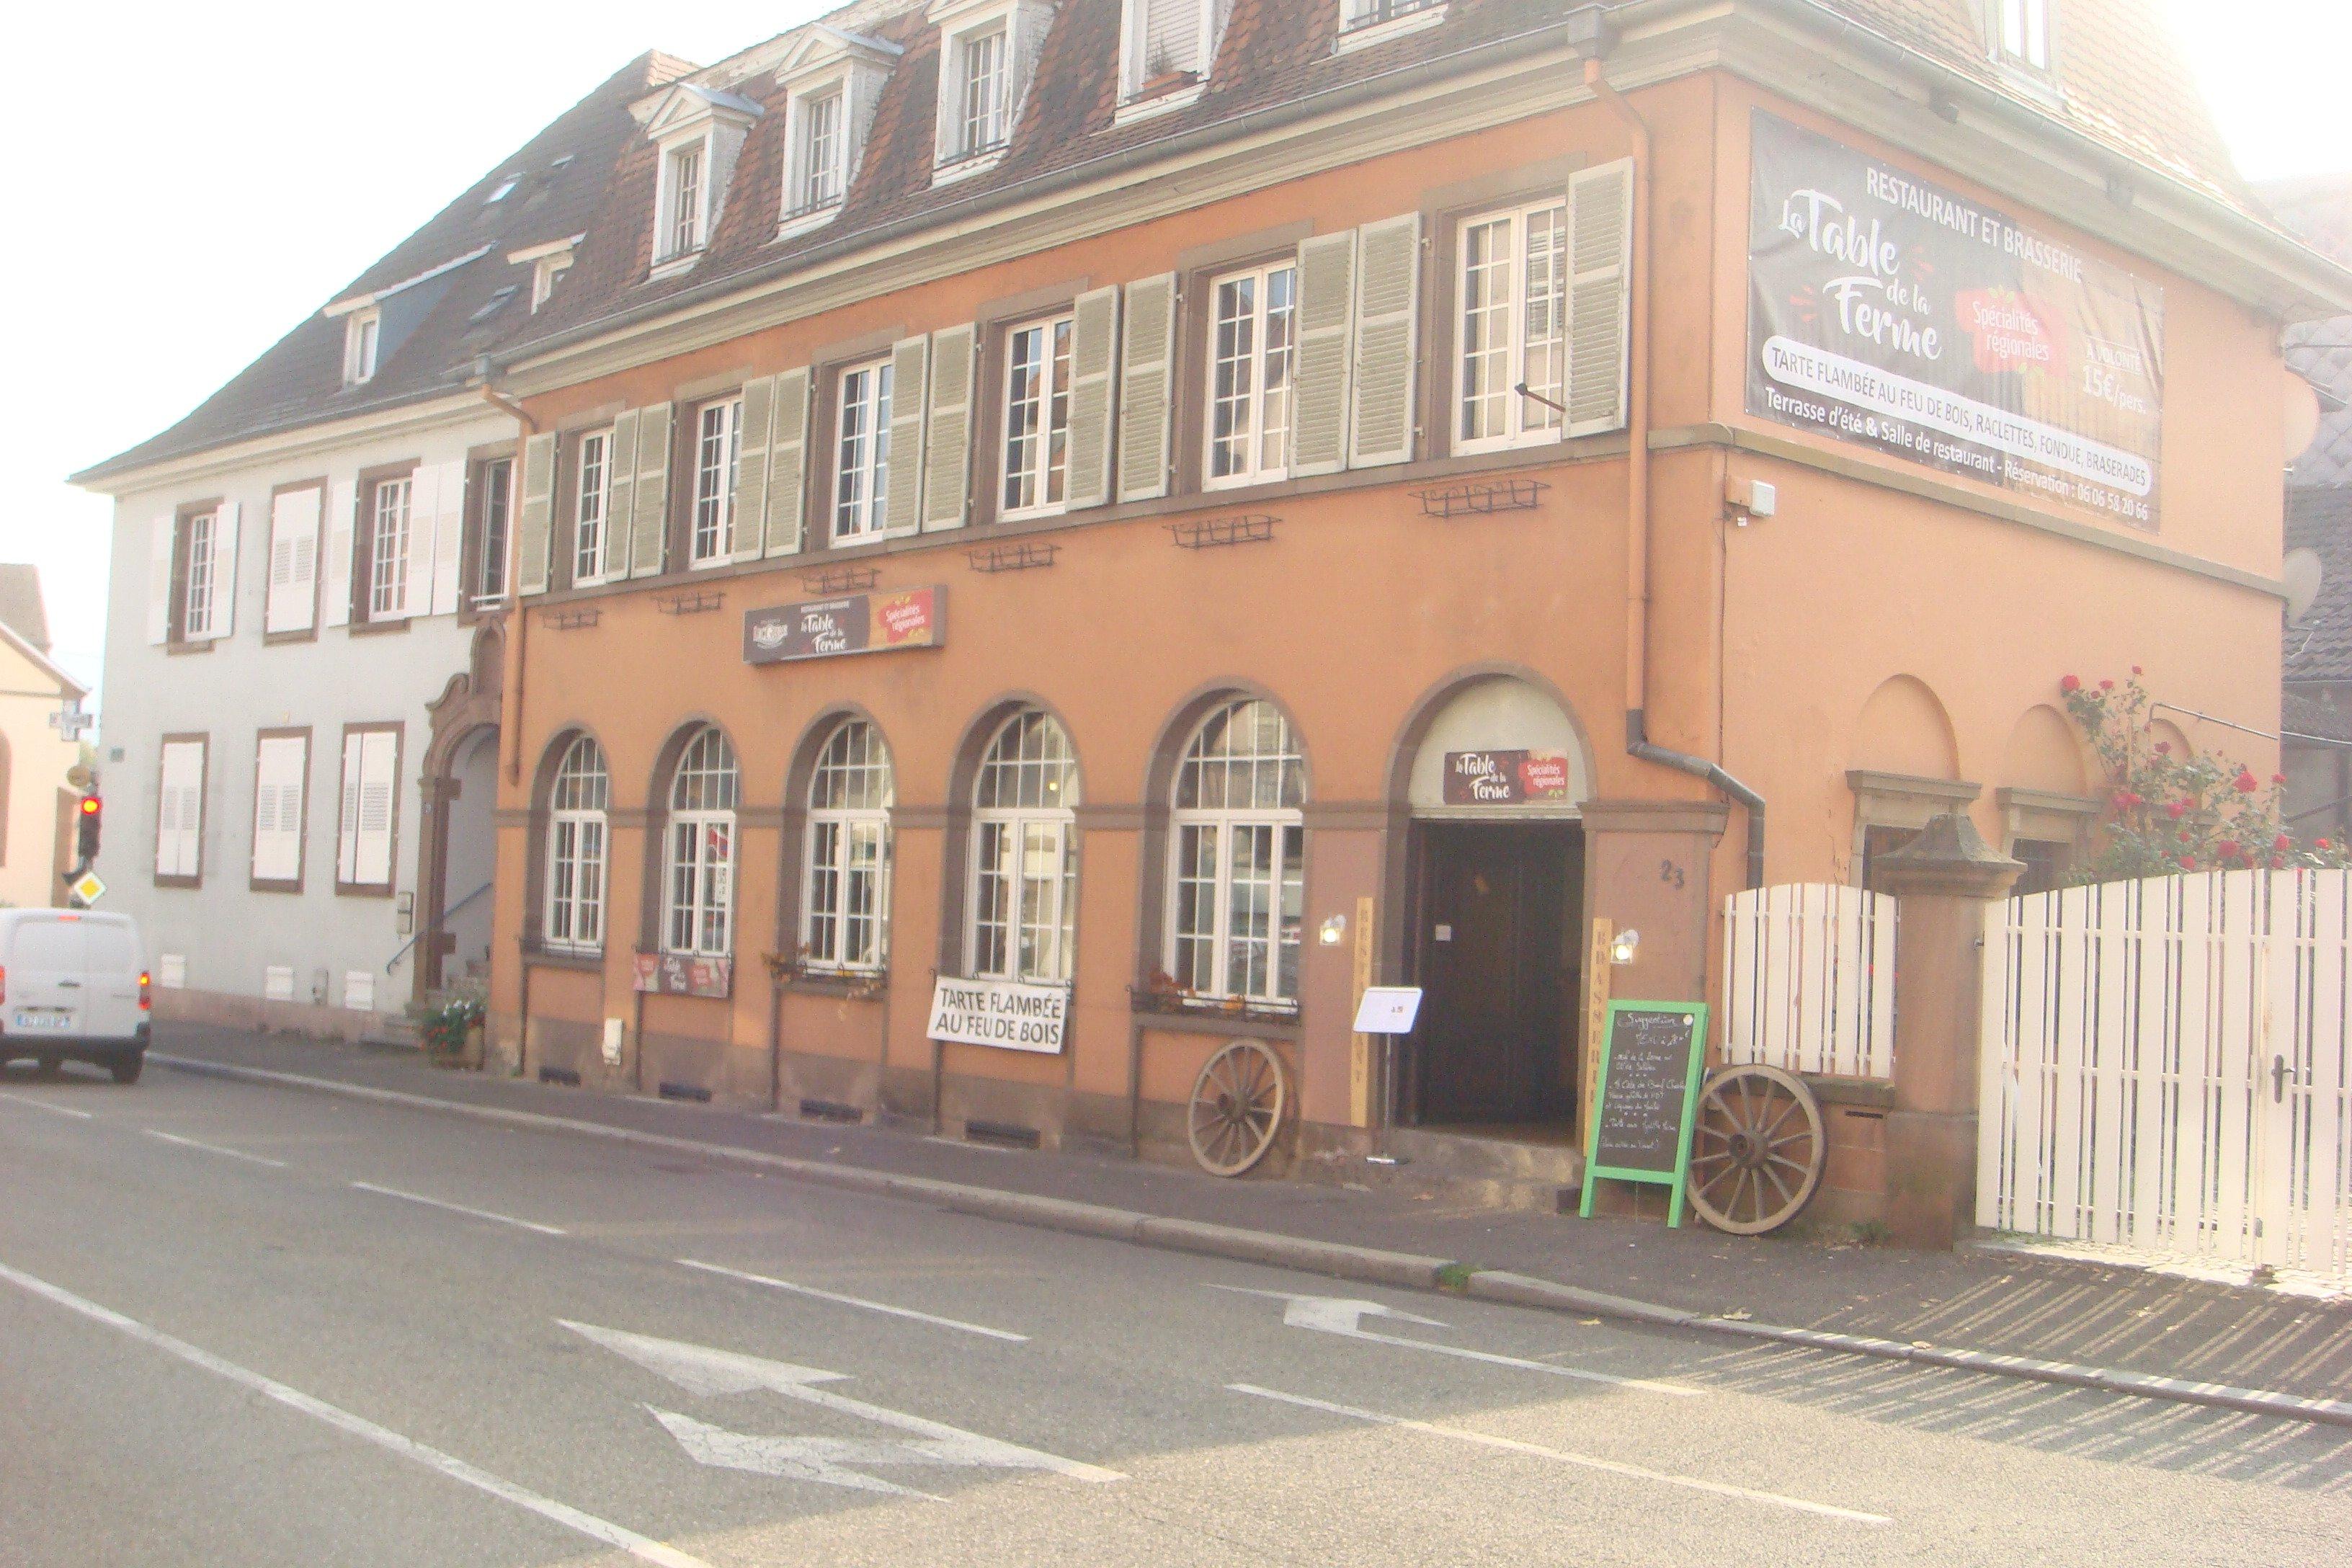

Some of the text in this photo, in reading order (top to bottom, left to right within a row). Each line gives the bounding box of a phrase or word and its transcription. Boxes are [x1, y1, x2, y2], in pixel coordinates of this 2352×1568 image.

[1778, 189, 1900, 277] La Table
[1866, 166, 2083, 284] RESTAURANT ET BRASSERIE
[1886, 277, 1931, 315] de la
[1822, 276, 1942, 360] Ferme
[1972, 300, 2039, 336] Spécialités
[1985, 331, 2050, 362] régionales
[1772, 347, 2146, 487] TARTE FLAMBÉE AU FEU DE BOIS, RACLETTES, FONDUE, BRASERADES
[1765, 386, 1826, 423] Terrasse
[1828, 406, 1862, 435] d'été
[1866, 417, 1879, 438] &
[1881, 421, 1912, 448] Salle
[1915, 432, 1930, 453] de
[1933, 440, 1995, 474] restaurant
[2004, 460, 2070, 497] Réservation
[803, 613, 834, 633] Table
[811, 632, 847, 654] Ferme
[1460, 753, 1497, 775] Table
[1469, 775, 1510, 800] Ferme
[940, 986, 1061, 1019] TARTE FLAMBÉE
[935, 1012, 1059, 1044] AU FEU DE BOIS
